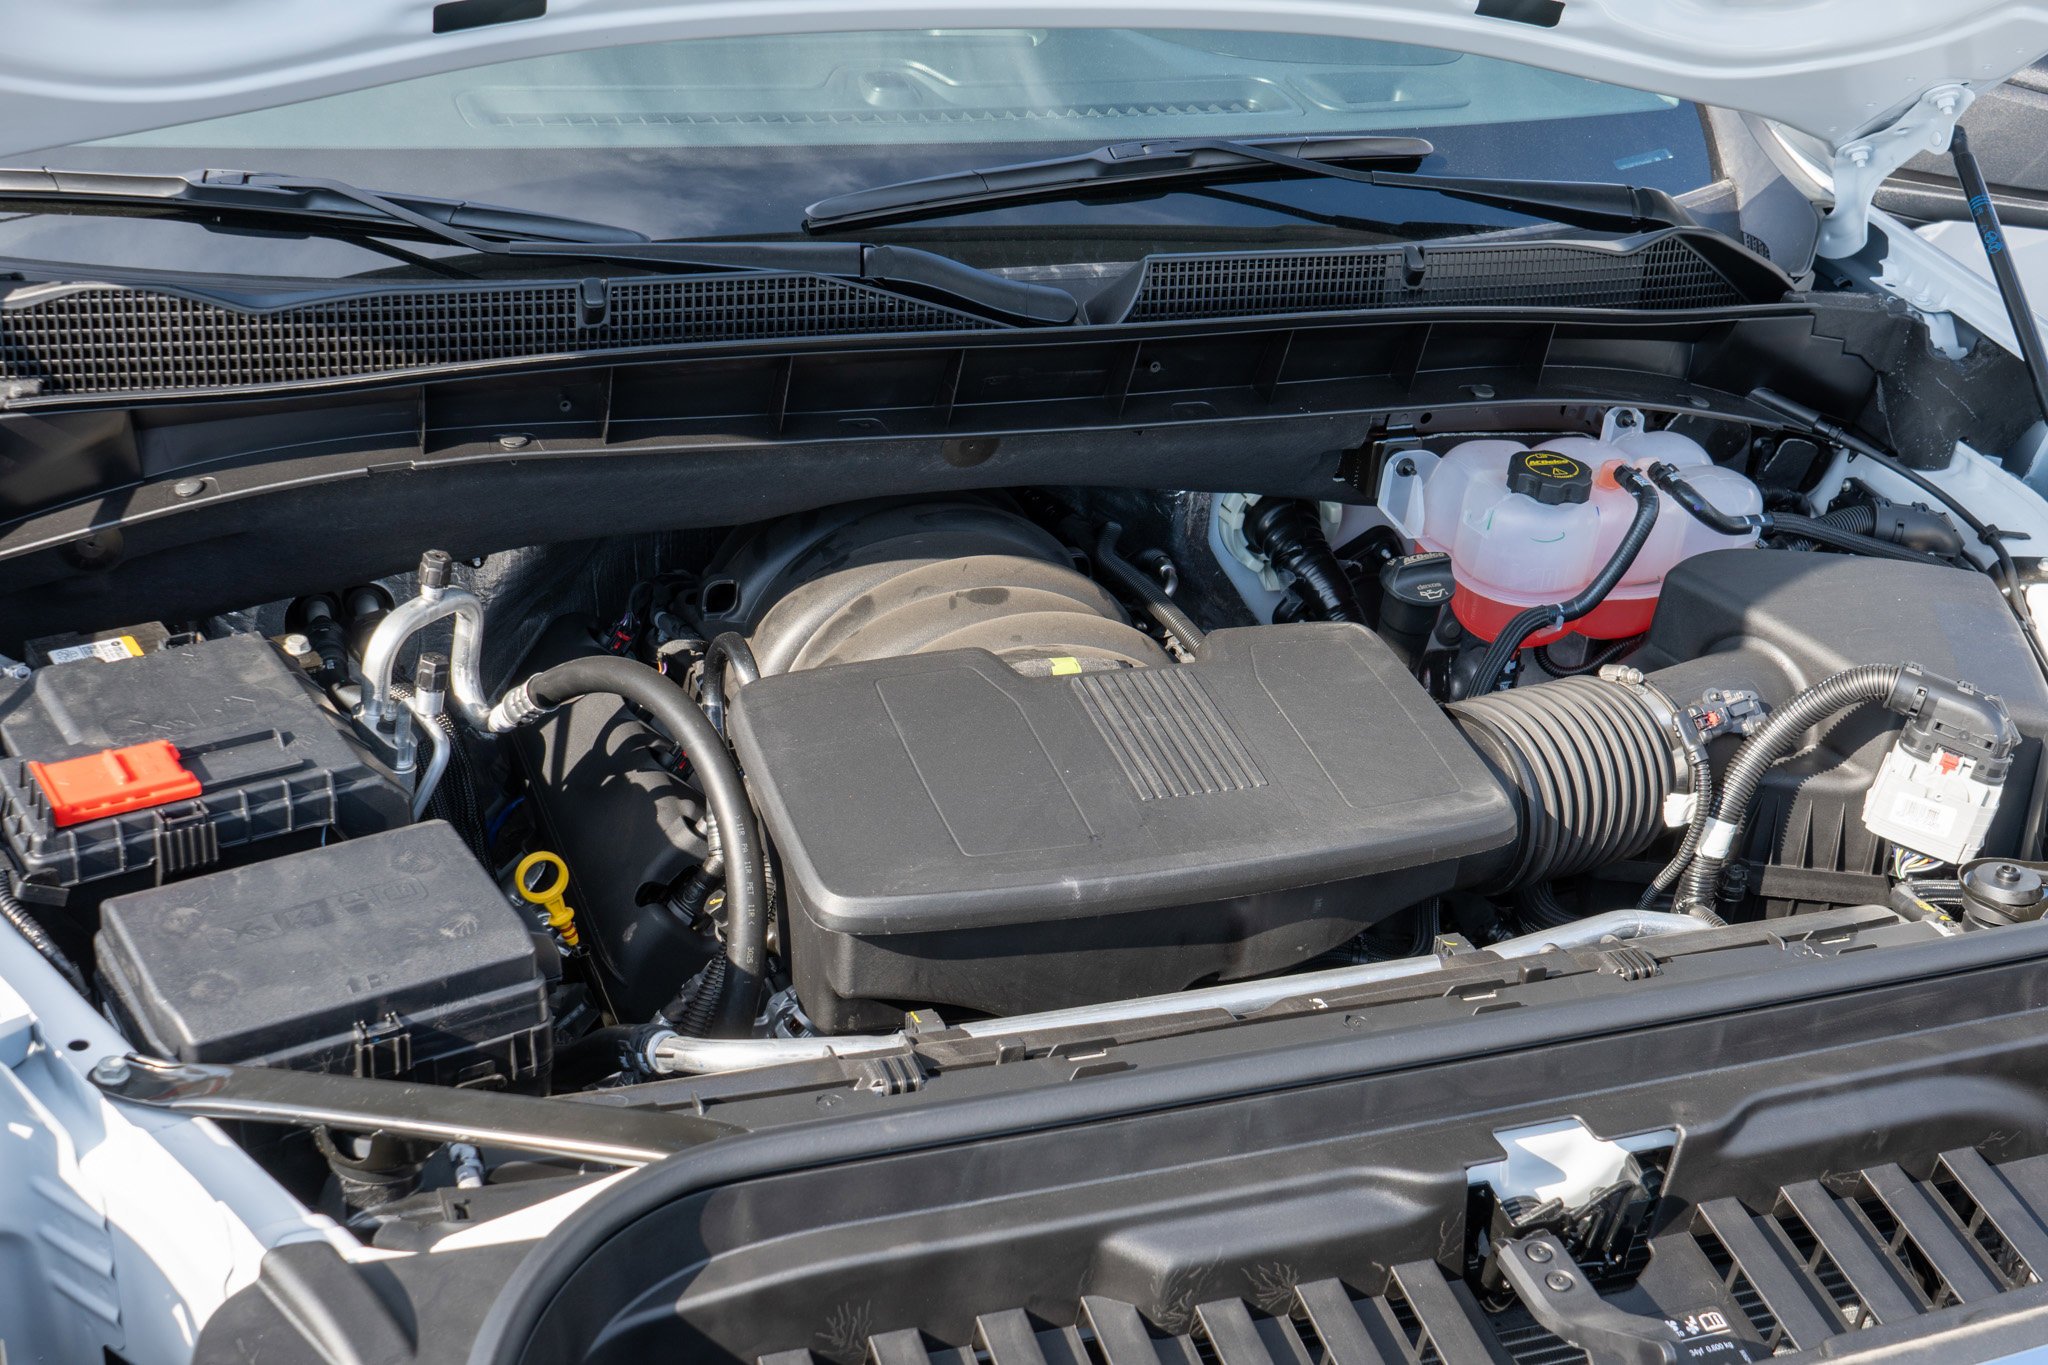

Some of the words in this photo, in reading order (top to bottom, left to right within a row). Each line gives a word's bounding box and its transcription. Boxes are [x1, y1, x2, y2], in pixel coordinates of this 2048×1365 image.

[1404, 552, 1445, 565] ACDelco
[1417, 582, 1441, 590] dexos
[1723, 1341, 1734, 1350] kg
